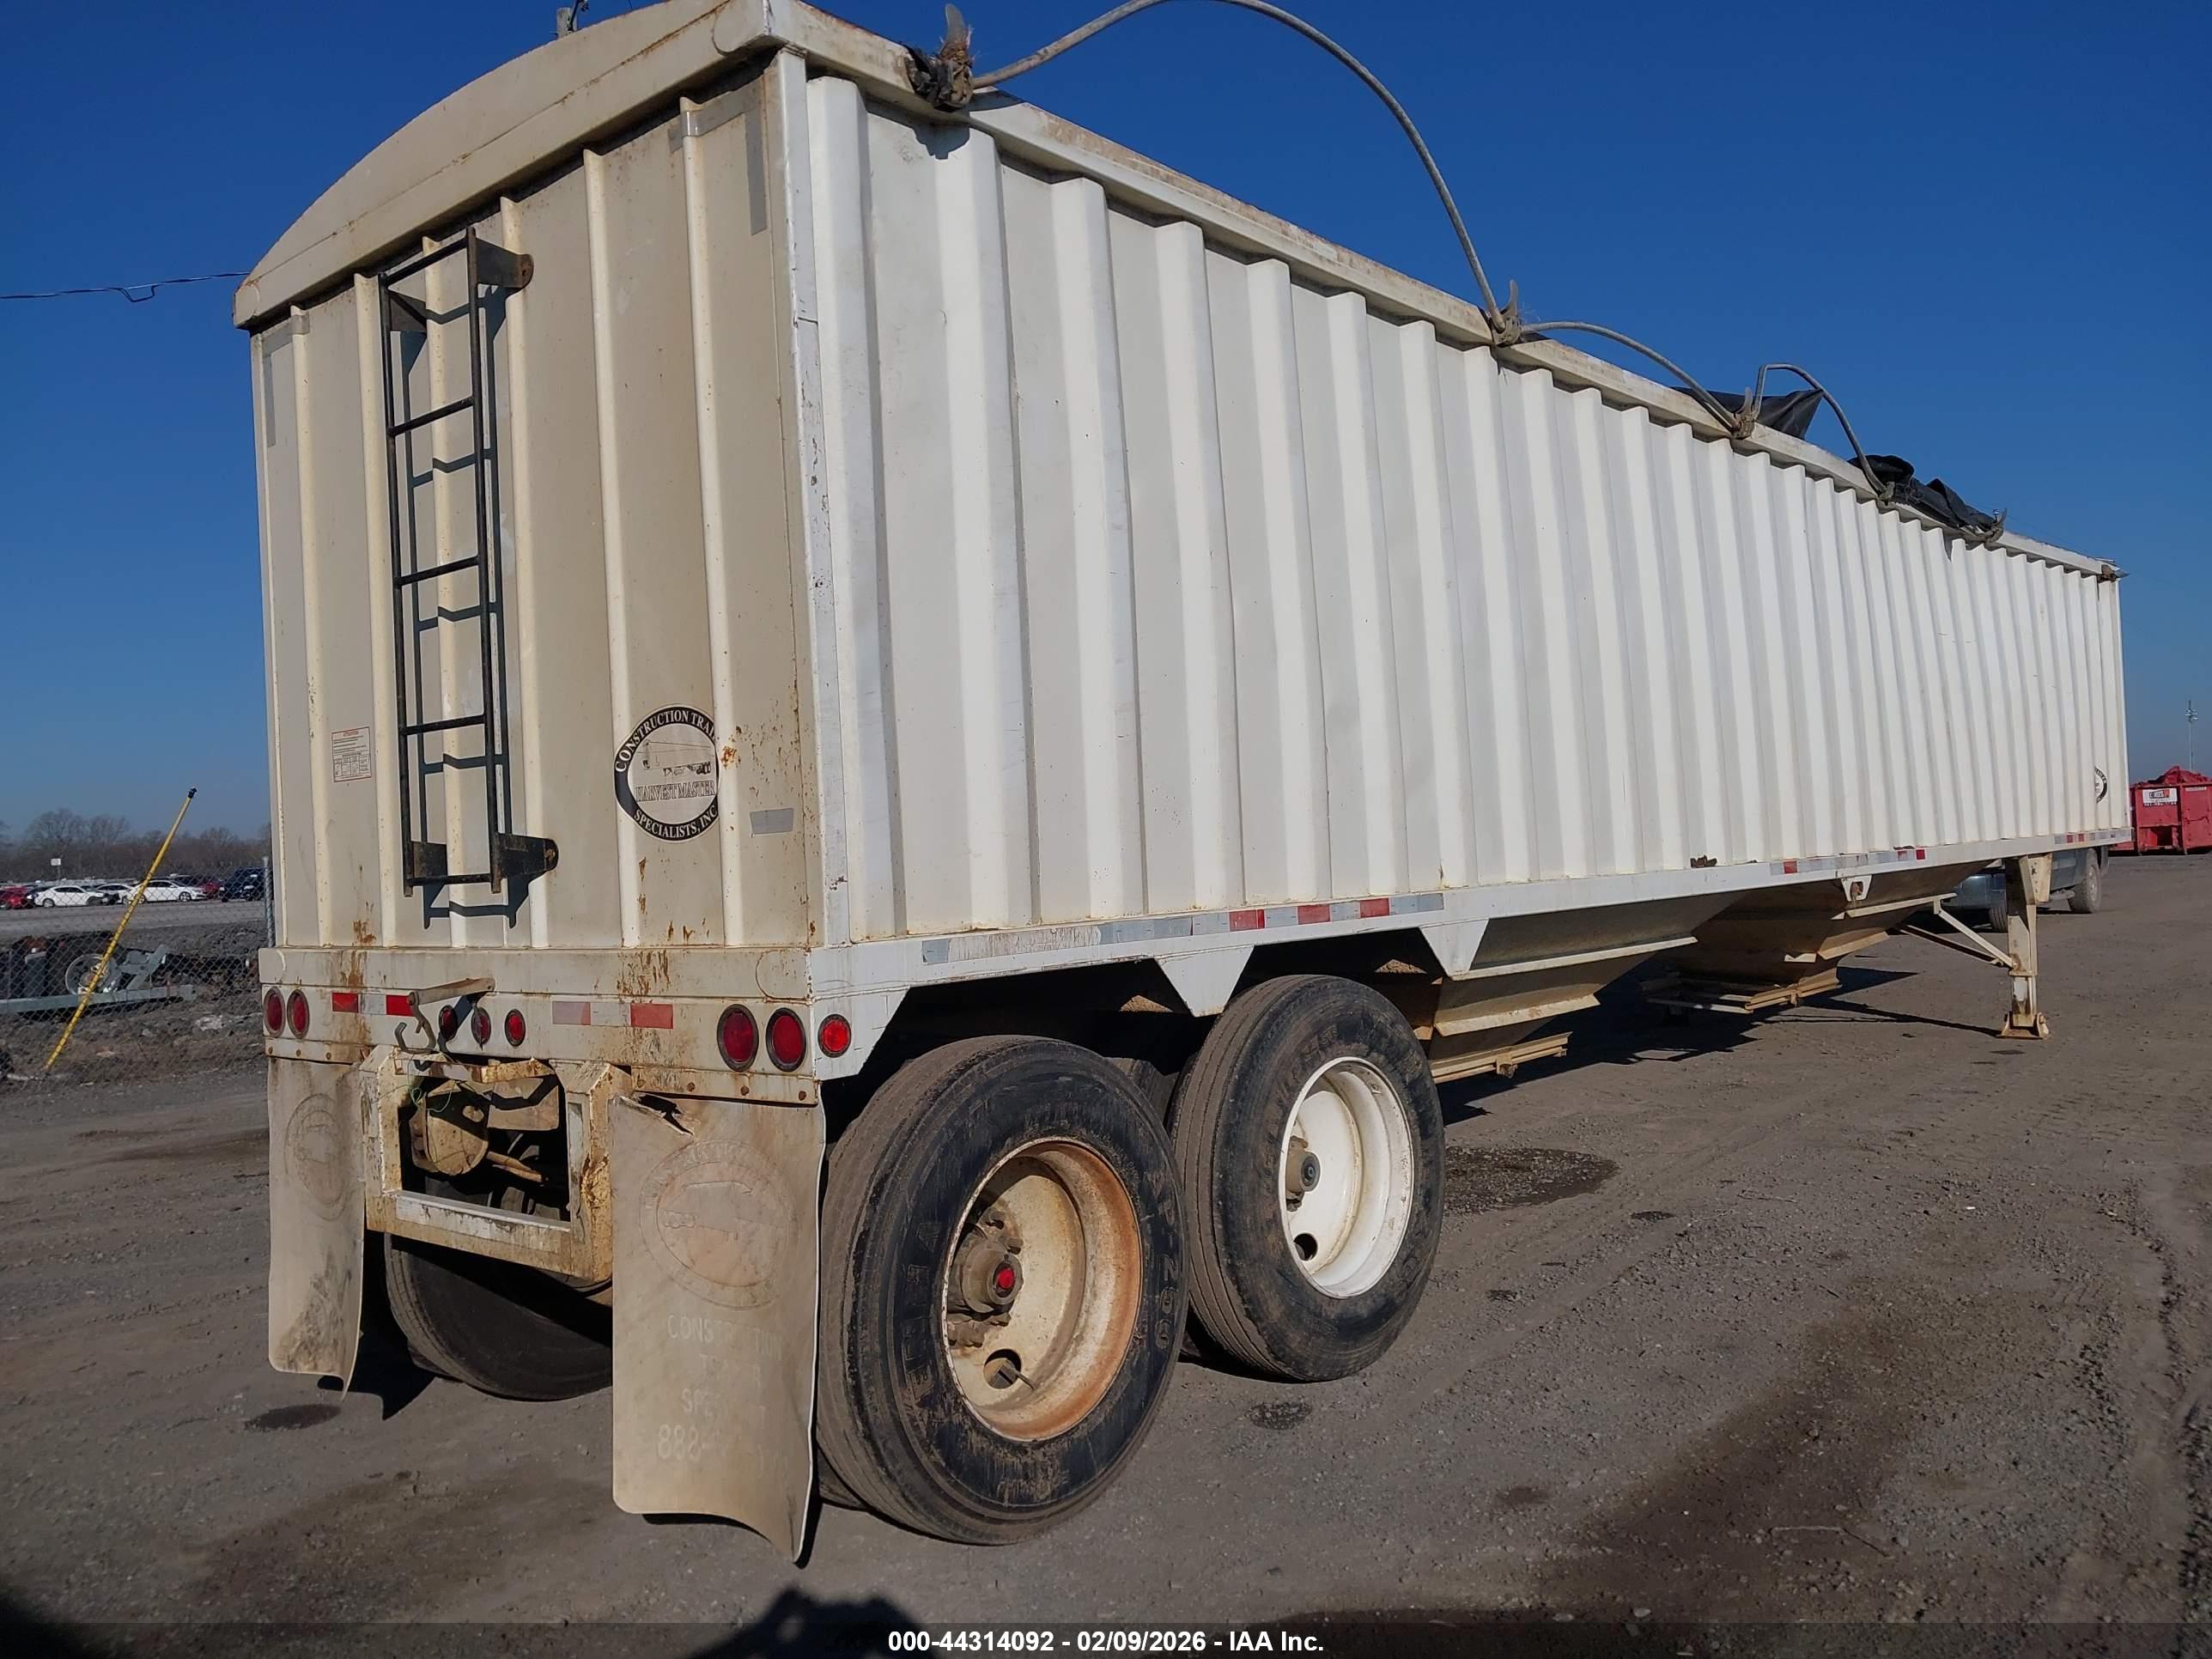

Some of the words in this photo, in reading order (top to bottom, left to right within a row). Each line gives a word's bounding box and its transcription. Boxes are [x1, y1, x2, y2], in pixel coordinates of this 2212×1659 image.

[615, 709, 689, 772] CONSTRUCTION
[636, 784, 678, 801] HARVEST
[678, 780, 715, 799] MASTER
[634, 809, 701, 838] SPECIALISTS,
